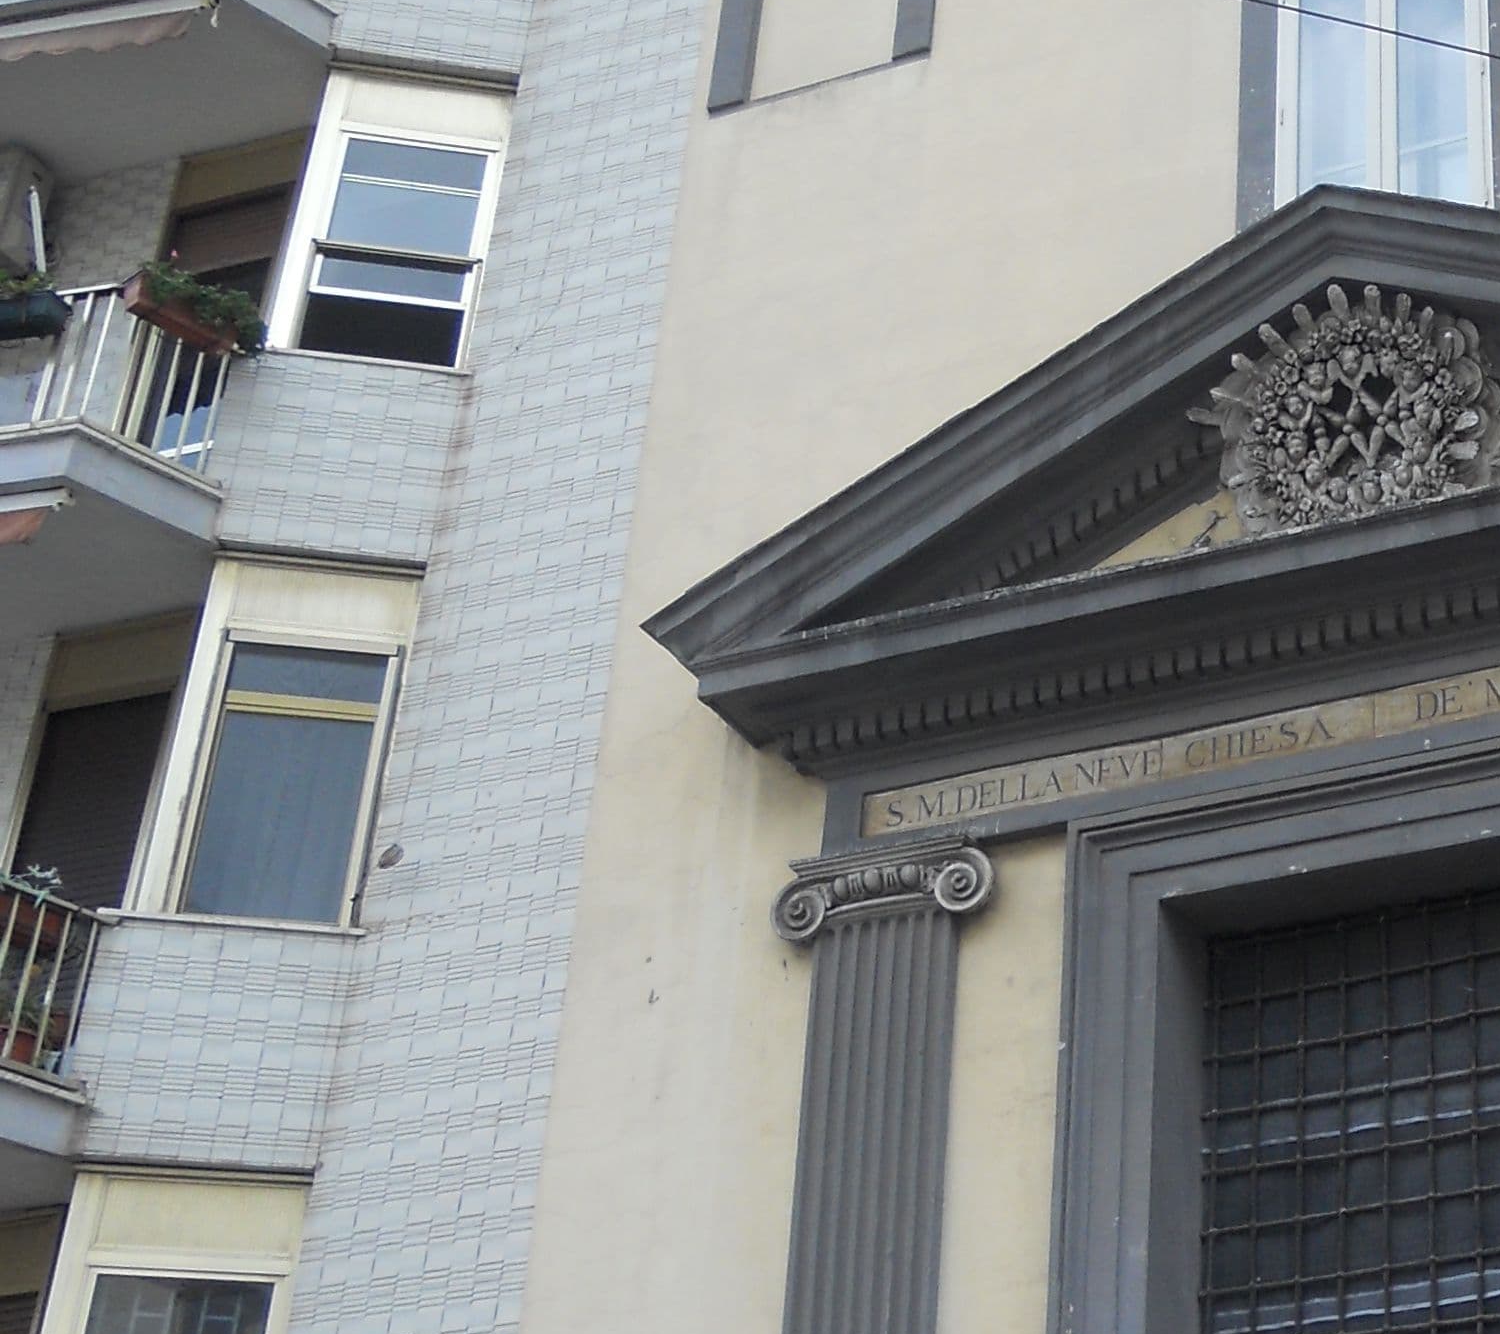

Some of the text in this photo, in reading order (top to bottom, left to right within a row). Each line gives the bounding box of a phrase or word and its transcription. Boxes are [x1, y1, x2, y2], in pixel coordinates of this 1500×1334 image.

[953, 771, 1062, 814] DELLA
[1075, 748, 1162, 789] NEVE
[1185, 716, 1336, 766] CHIESA
